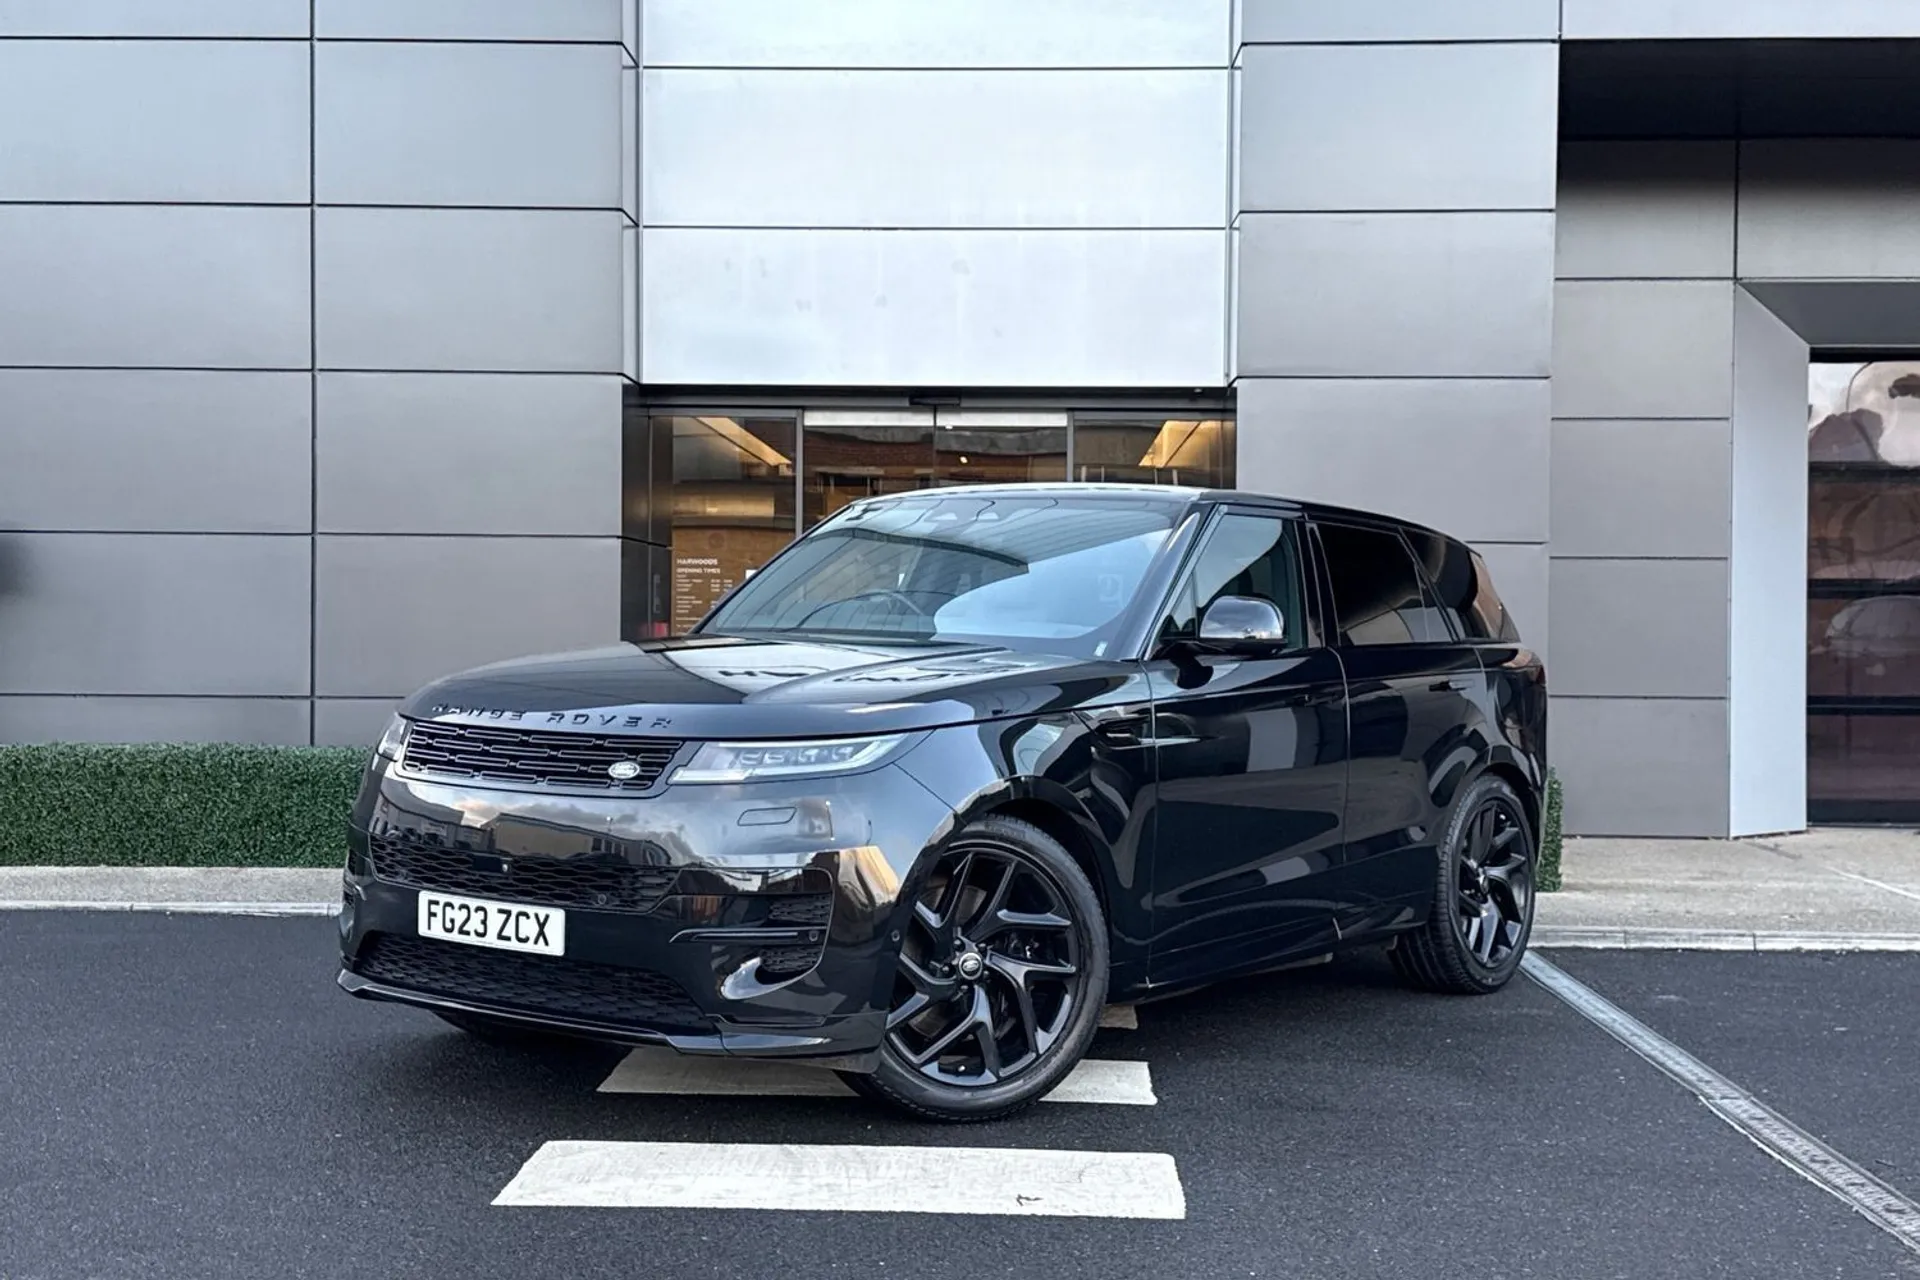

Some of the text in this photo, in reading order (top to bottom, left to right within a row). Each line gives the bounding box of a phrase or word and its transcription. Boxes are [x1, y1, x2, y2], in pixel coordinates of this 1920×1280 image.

[432, 703, 673, 729] RANGE ROVER
[427, 899, 550, 946] FG23 ZCX
